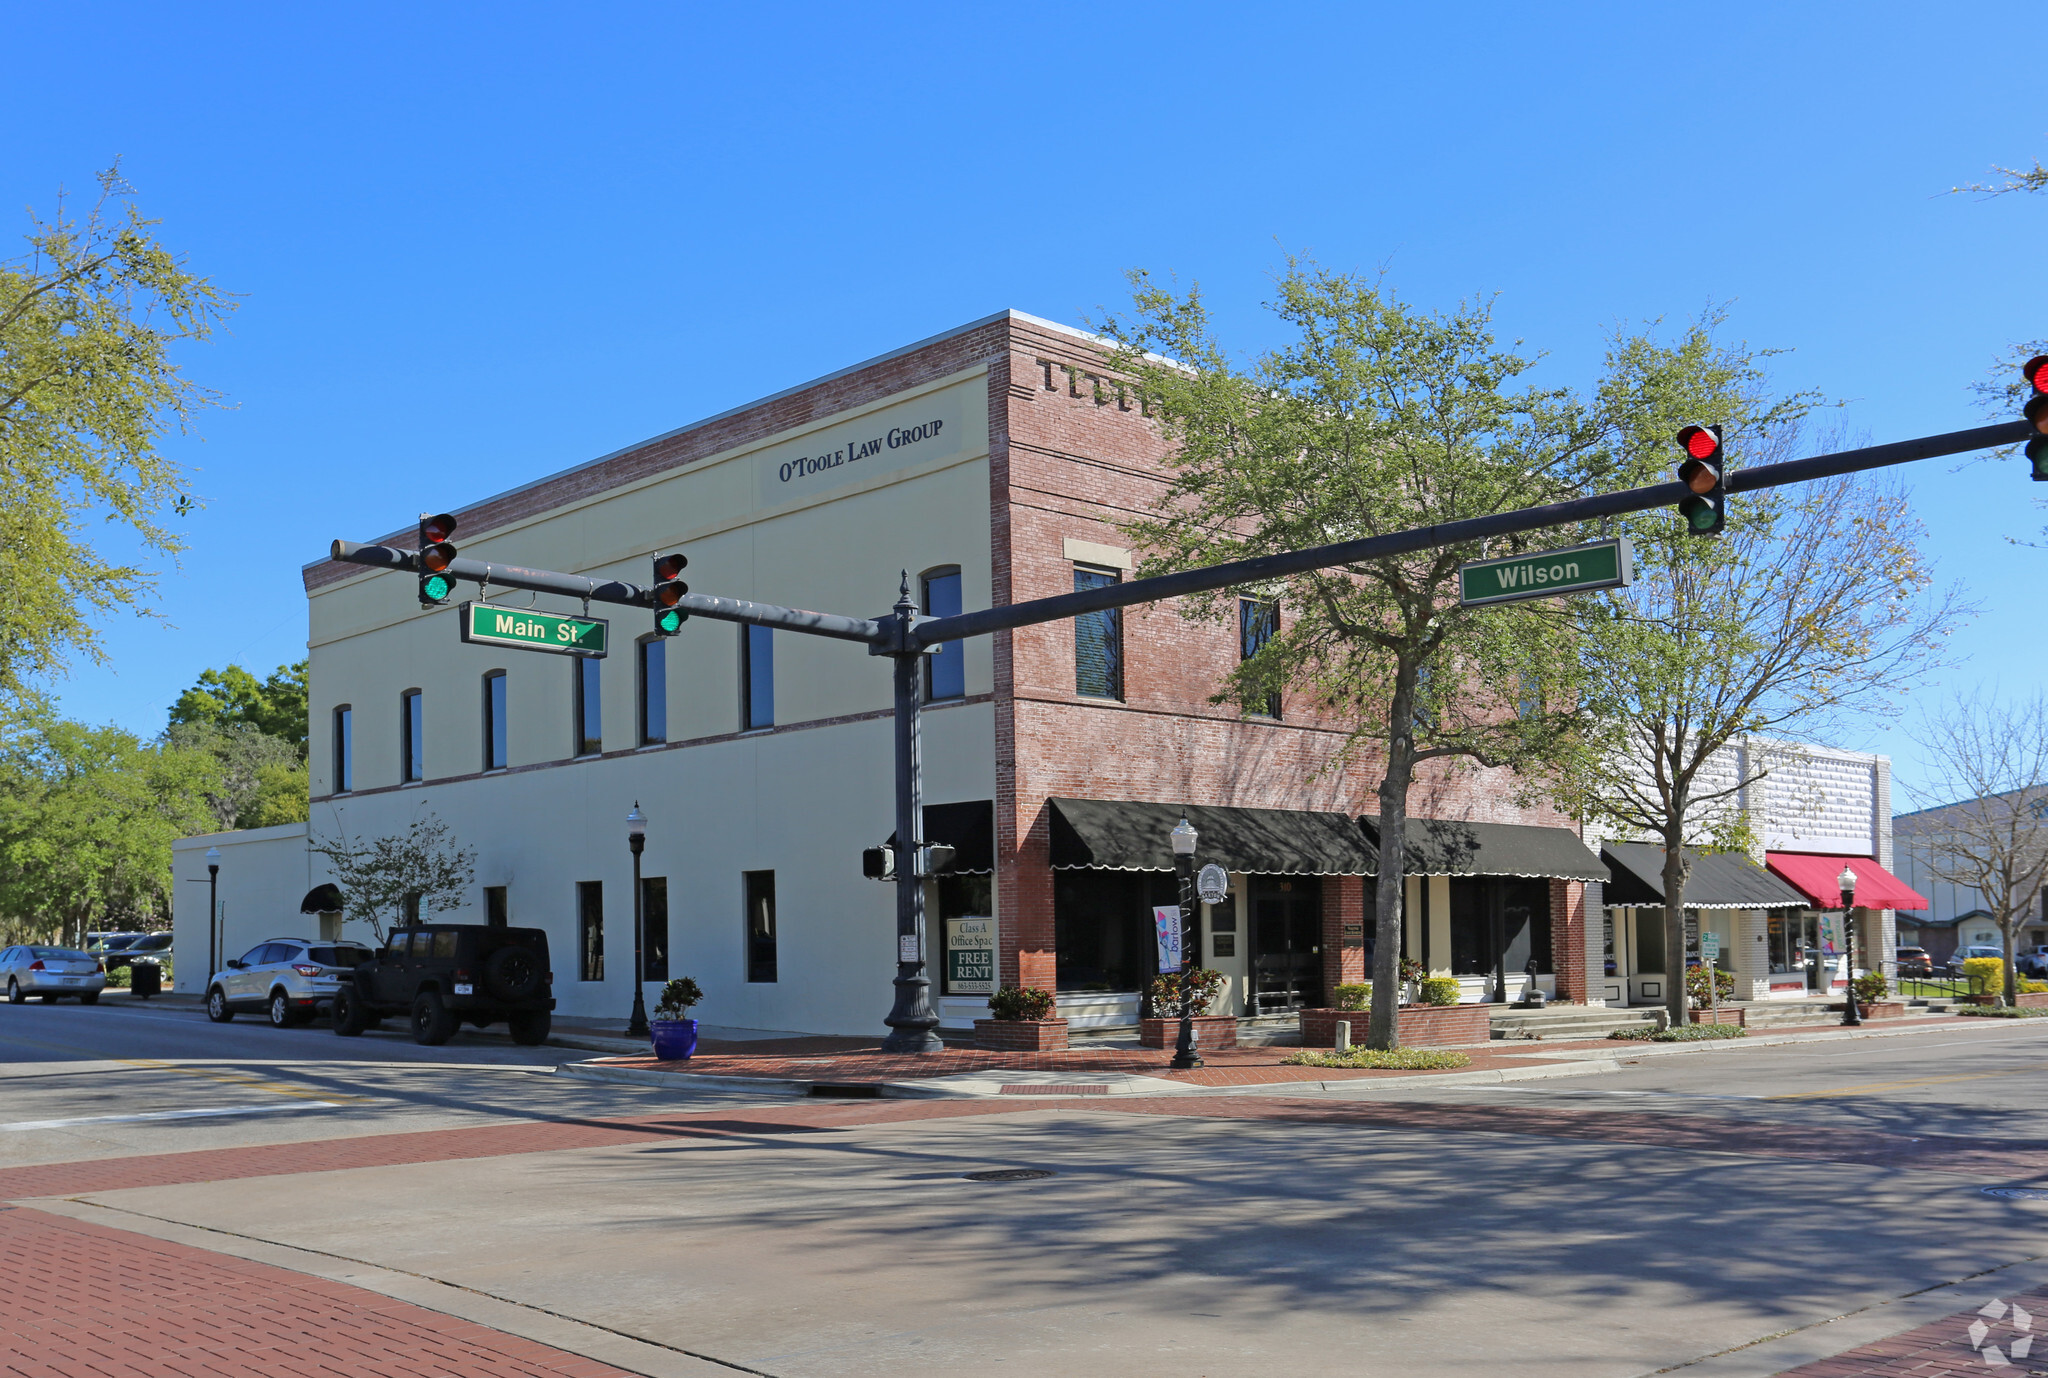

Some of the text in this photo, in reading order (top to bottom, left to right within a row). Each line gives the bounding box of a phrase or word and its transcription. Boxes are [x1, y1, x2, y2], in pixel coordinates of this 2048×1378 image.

[848, 438, 882, 462] LAW
[887, 419, 943, 449] GROUP
[1496, 562, 1580, 589] Wilson
[495, 614, 584, 644] Main St.
[959, 922, 987, 934] Class A
[951, 935, 973, 946] Office
[958, 952, 989, 965] FREE
[957, 966, 992, 978] RENT
